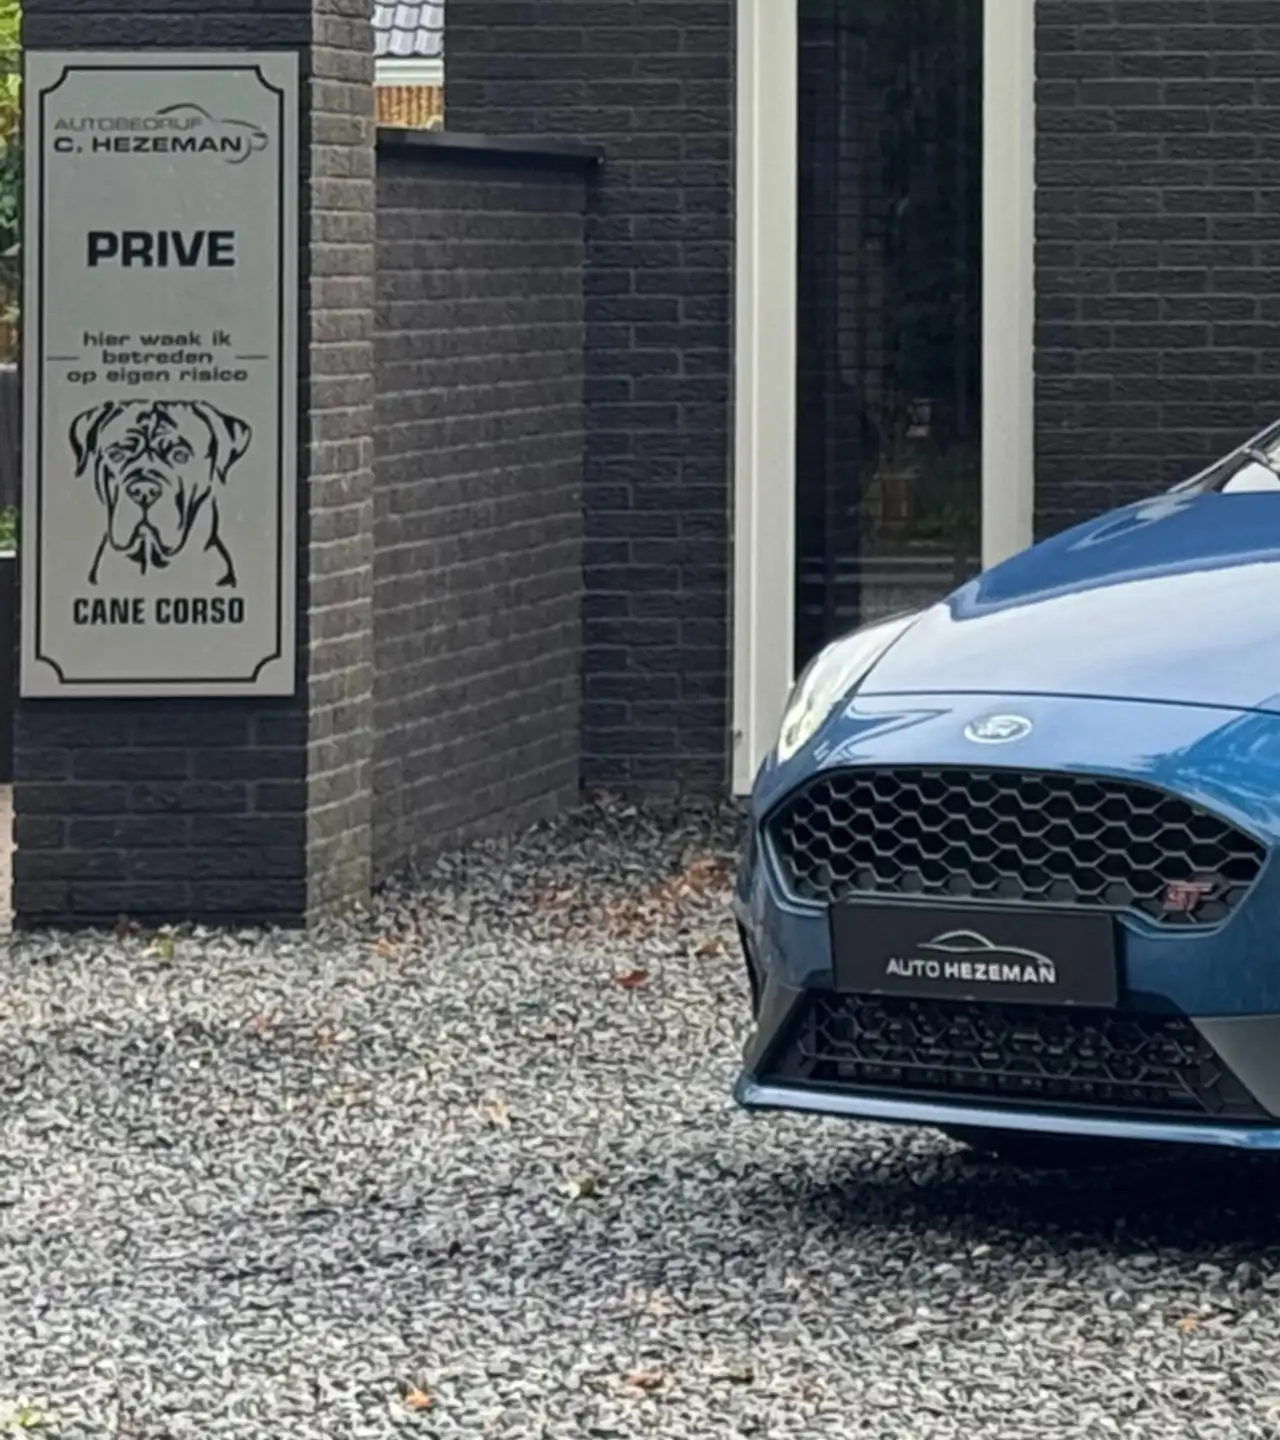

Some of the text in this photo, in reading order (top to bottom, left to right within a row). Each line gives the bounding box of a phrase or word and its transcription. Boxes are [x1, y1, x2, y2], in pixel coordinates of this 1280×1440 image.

[53, 136, 242, 153] C. HEZEMAN
[87, 230, 236, 267] PRIVE
[83, 330, 232, 347] hier waak ik
[102, 349, 213, 365] betreden
[66, 366, 248, 386] op eigen risico
[73, 596, 245, 625] CANE CORSO
[885, 957, 1057, 984] AUTO HEZEMAN
